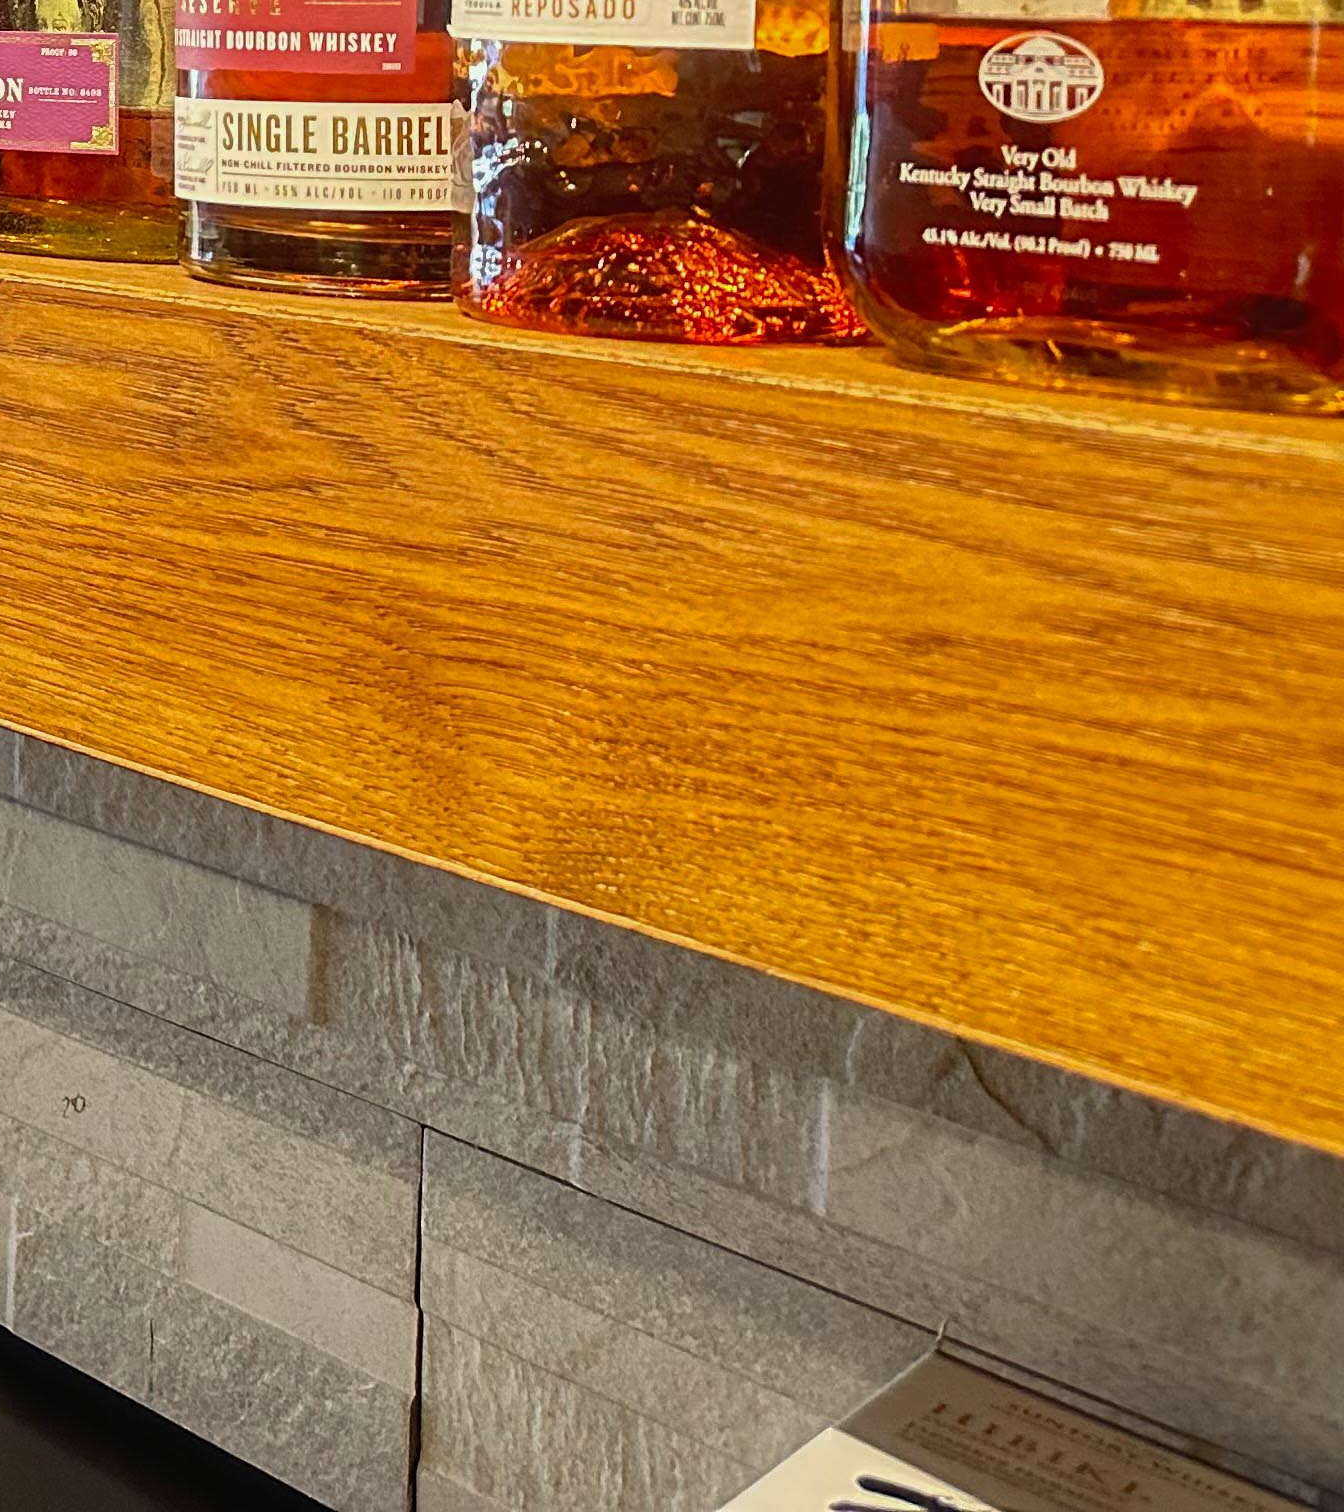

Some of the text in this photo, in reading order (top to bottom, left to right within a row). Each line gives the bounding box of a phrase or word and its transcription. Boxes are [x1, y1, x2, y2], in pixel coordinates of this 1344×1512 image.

[176, 28, 398, 53] STRAIGHT BOURBON WHISKEY
[28, 86, 60, 97] BOTTLE
[221, 111, 318, 155] SINGLE
[331, 115, 449, 157] BARREL
[221, 158, 448, 175] NON-CHILL FILTERED BOURBON WHISKEY
[1002, 144, 1077, 171] Very Old
[221, 181, 239, 194] 750
[245, 182, 259, 196] ML
[305, 186, 364, 200] ALC/VOL
[382, 187, 403, 201] 110
[410, 188, 449, 201] PROOF
[899, 162, 1199, 208] Kentucky Straight Bourbon Whiskey
[969, 191, 1110, 223] Very Small Batch
